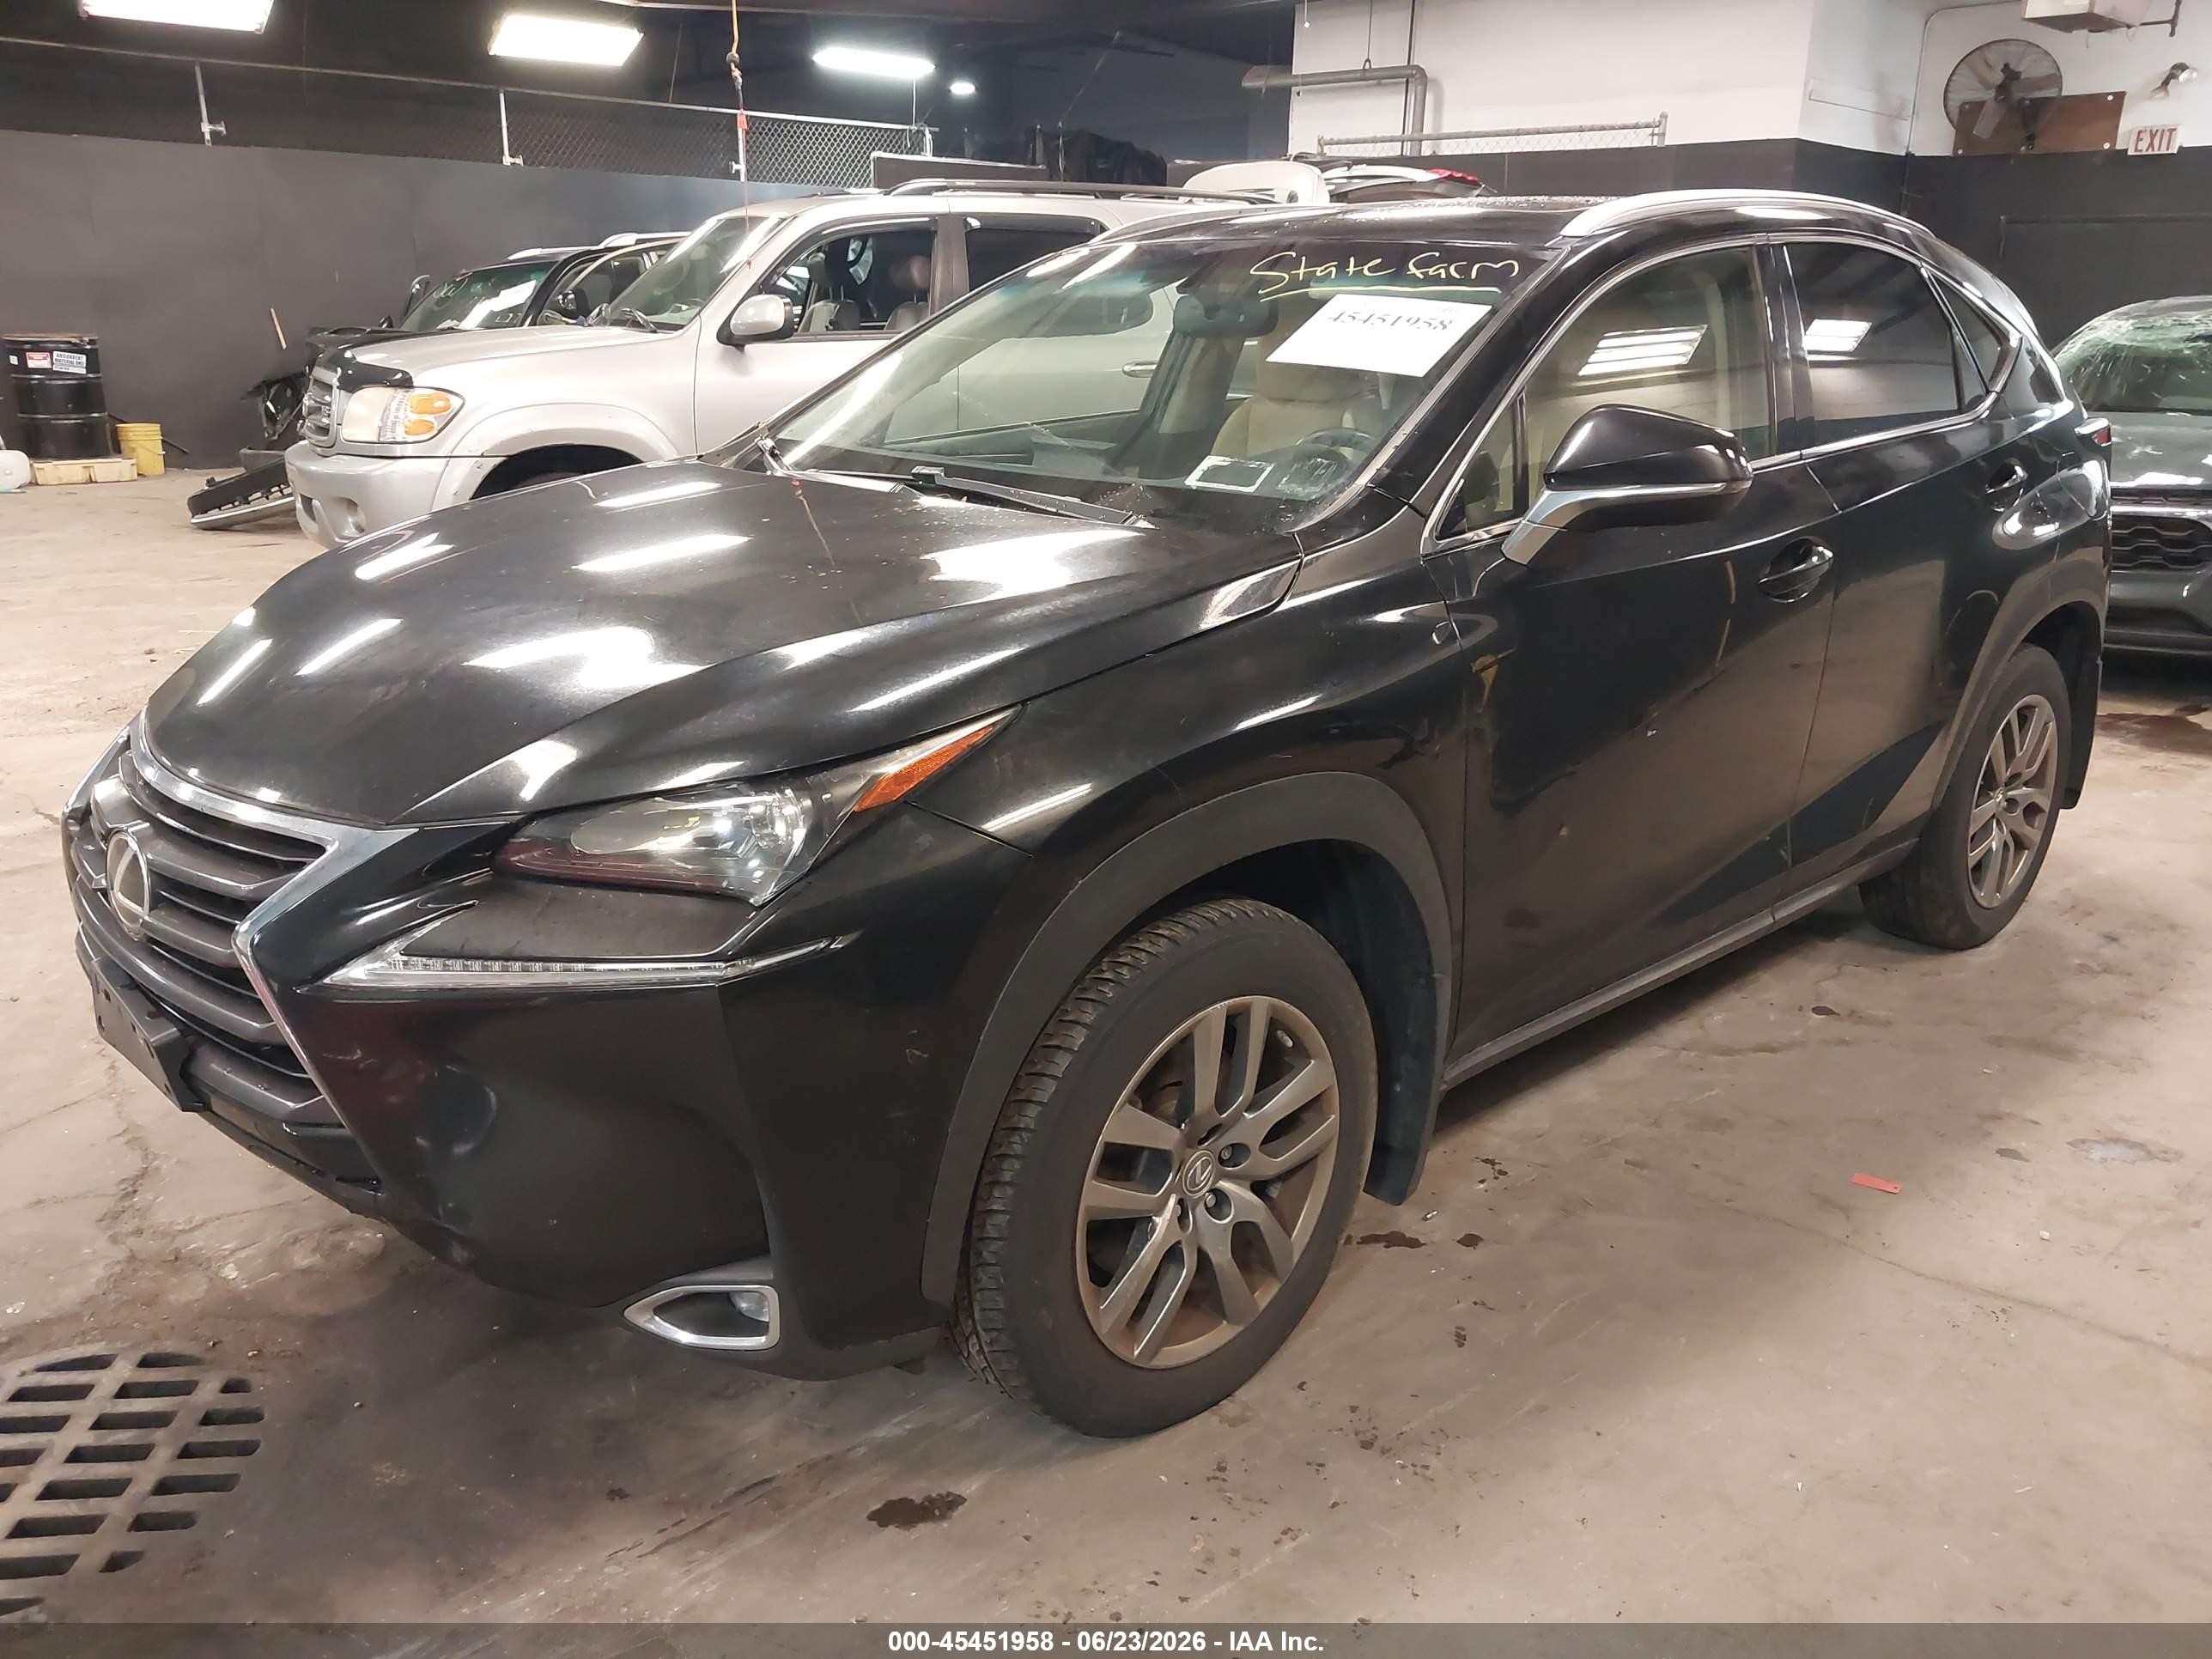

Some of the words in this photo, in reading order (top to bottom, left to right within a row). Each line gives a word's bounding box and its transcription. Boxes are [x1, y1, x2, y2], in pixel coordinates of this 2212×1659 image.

[2134, 127, 2177, 152] EXIT
[1249, 251, 1396, 295] State
[1328, 311, 1453, 331] 45451958
